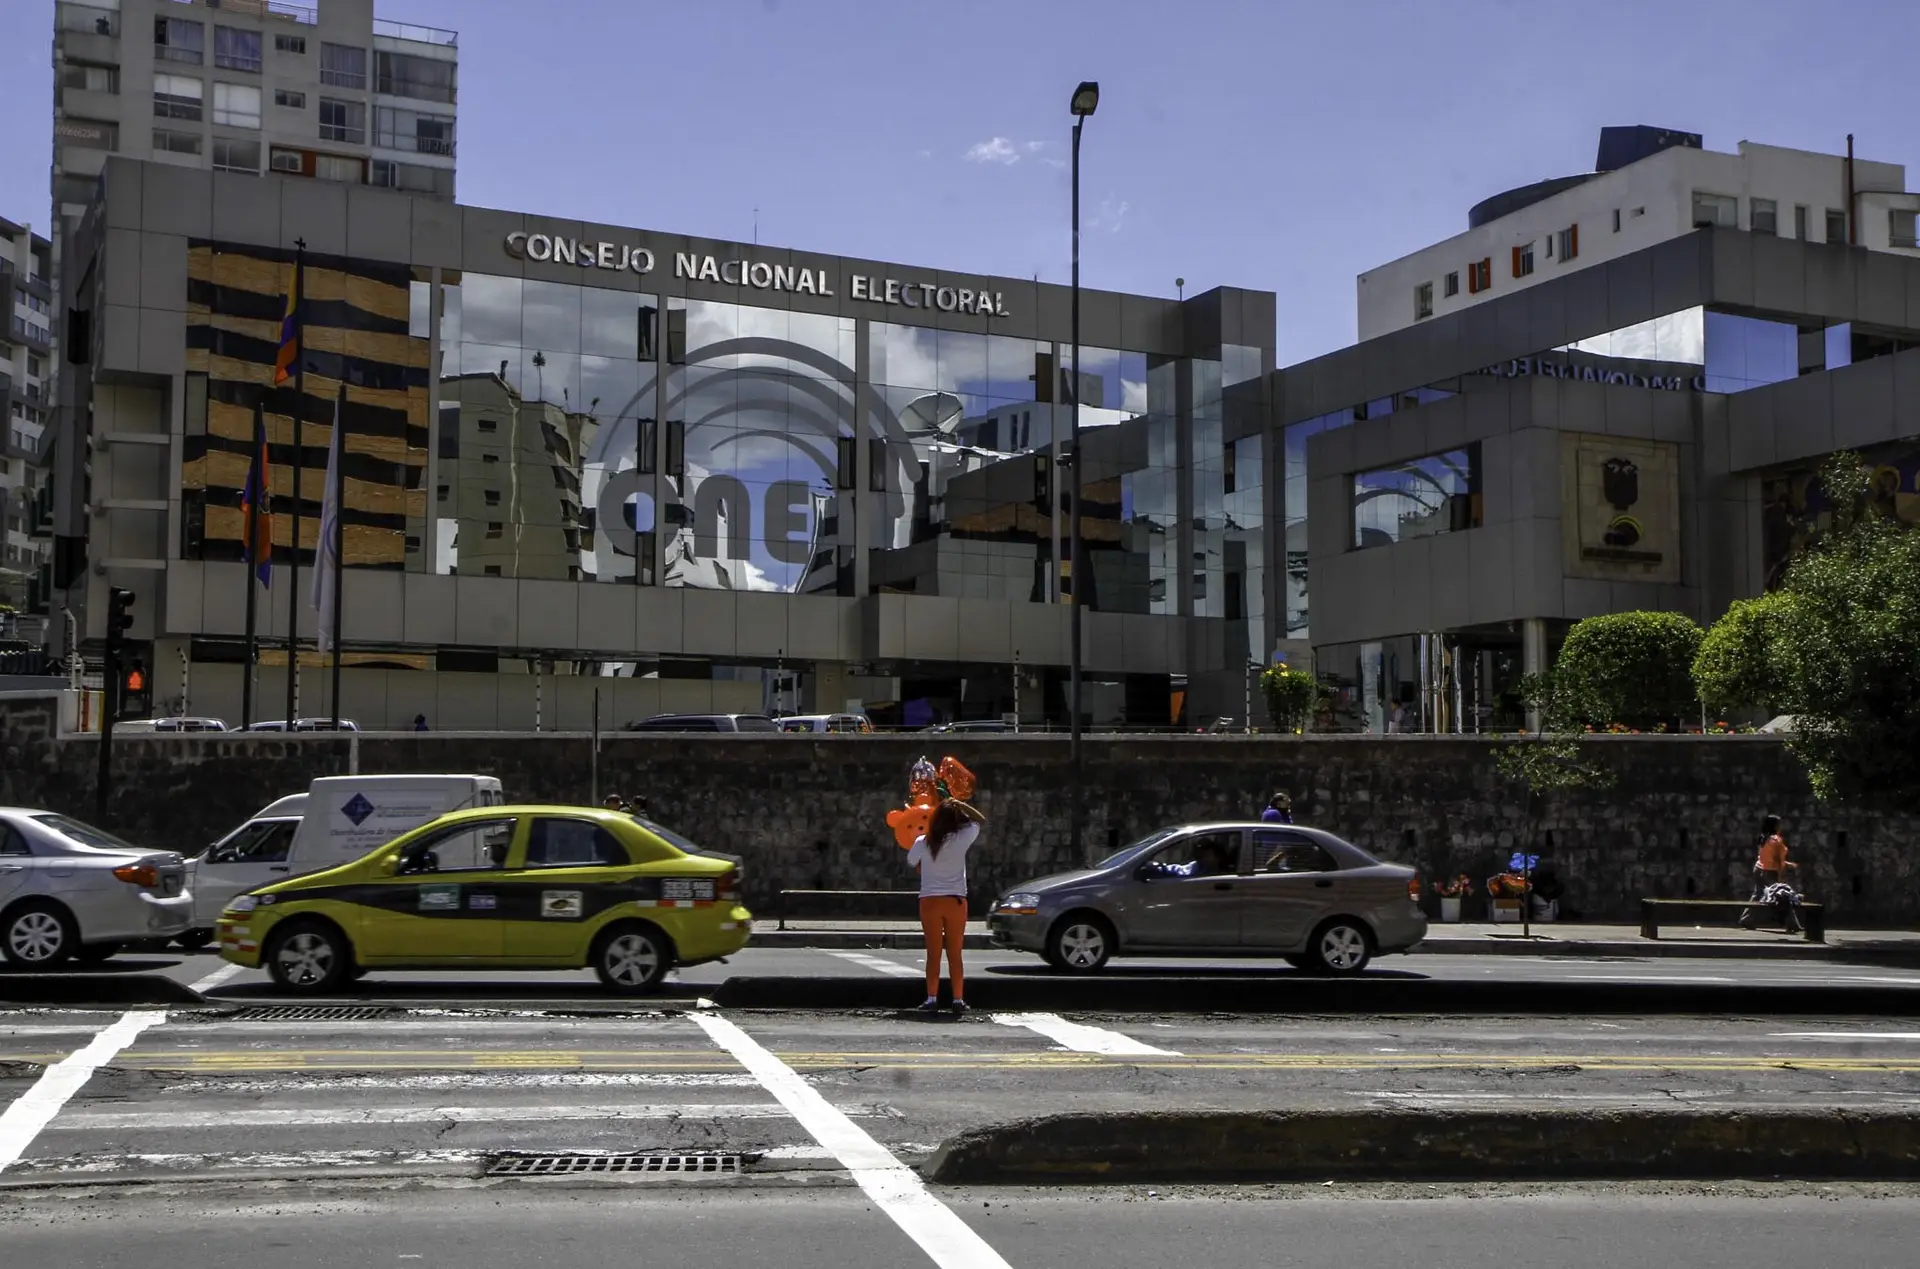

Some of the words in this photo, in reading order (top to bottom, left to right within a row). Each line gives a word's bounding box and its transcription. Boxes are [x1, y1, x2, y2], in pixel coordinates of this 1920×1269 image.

[505, 231, 655, 273] CONSEJO
[676, 251, 834, 296] NACIONAL
[851, 275, 1010, 316] ELECTORAL
